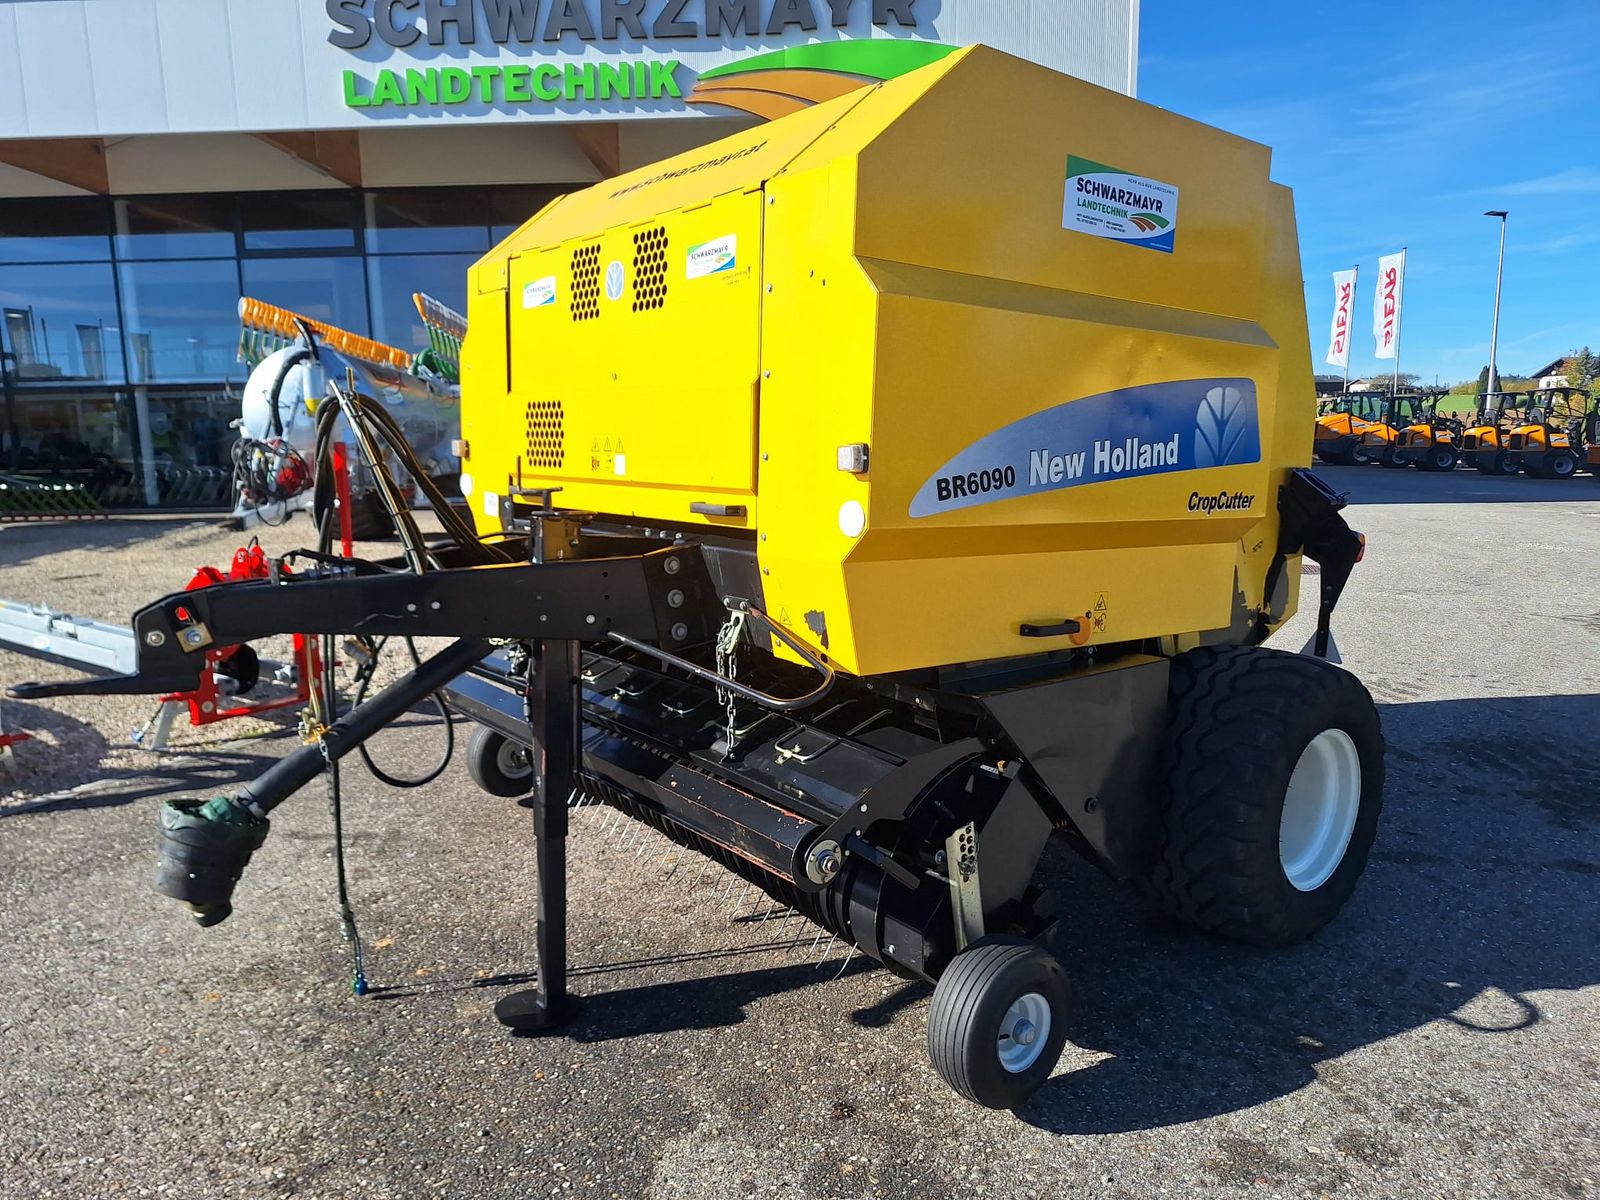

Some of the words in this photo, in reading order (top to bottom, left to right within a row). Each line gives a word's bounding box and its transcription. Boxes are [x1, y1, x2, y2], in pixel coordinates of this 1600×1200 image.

[342, 60, 683, 107] LANDTECHNIK
[1076, 177, 1163, 213] SCHWARZMAYR
[1077, 197, 1129, 219] LANDTECHNIK
[936, 465, 1016, 502] BR6090
[1029, 449, 1086, 487] New
[1093, 432, 1180, 475] Holland
[1188, 491, 1255, 515] CropCutter
